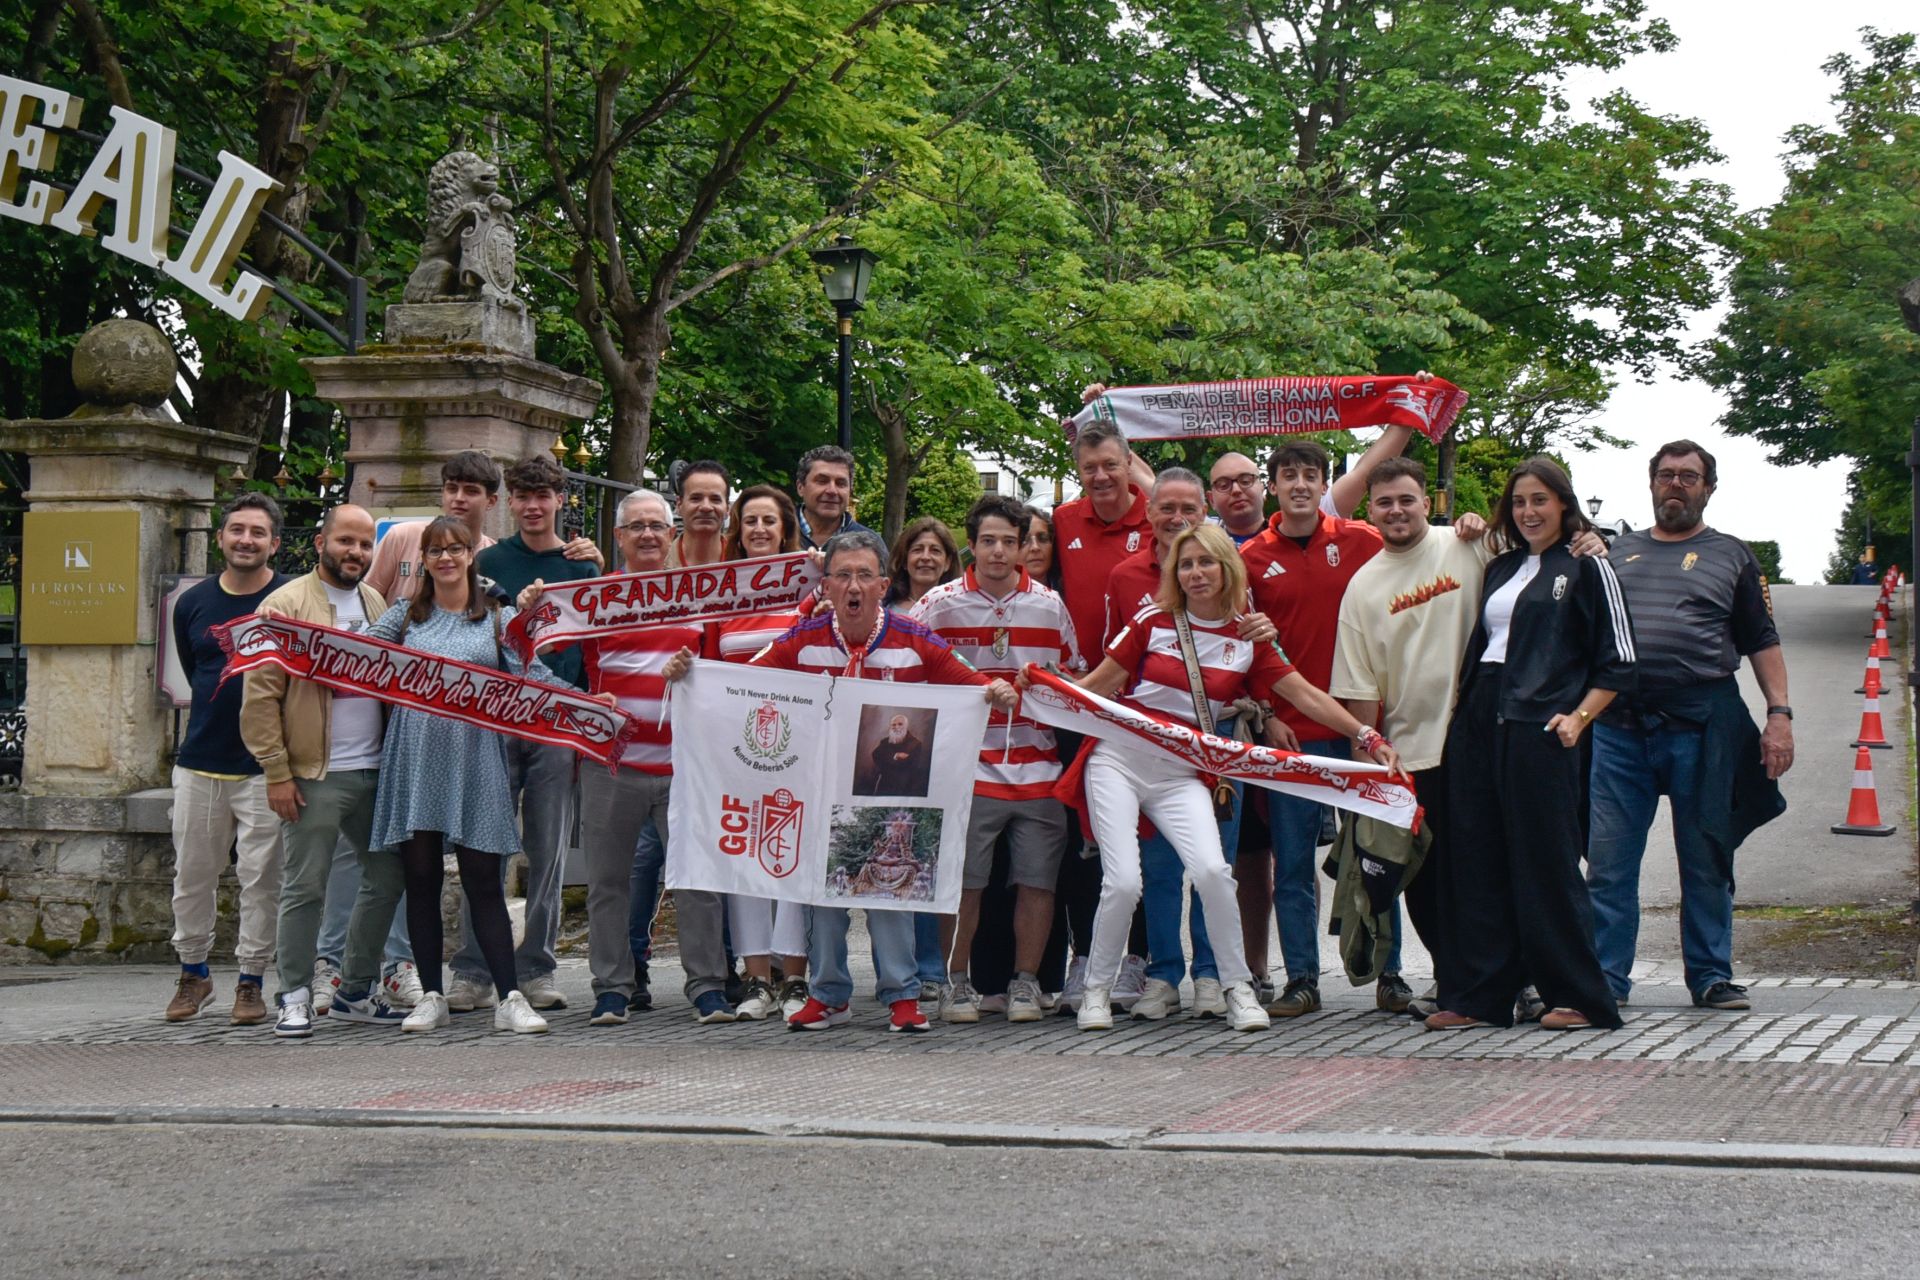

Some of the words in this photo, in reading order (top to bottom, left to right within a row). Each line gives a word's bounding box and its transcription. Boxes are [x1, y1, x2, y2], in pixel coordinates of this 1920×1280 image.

[1142, 390, 1201, 411] PEÑA
[1206, 389, 1250, 407] DEL
[1253, 382, 1331, 406] GRANÁ
[1340, 382, 1377, 400] C.F.
[1182, 406, 1340, 431] BARCELONA
[31, 582, 126, 594] EUROSTARS
[573, 567, 737, 625] GRANADA
[751, 559, 808, 591] C.F.
[308, 630, 395, 689] Granada
[398, 659, 443, 700] Club
[446, 671, 477, 708] de
[726, 686, 746, 697] You'll
[747, 690, 768, 699] Never
[770, 692, 790, 702] Drink
[792, 695, 813, 705] Alone
[731, 745, 753, 766] Nunca
[1200, 733, 1244, 753] Club
[1250, 746, 1277, 765] de
[719, 794, 750, 855] GCF
